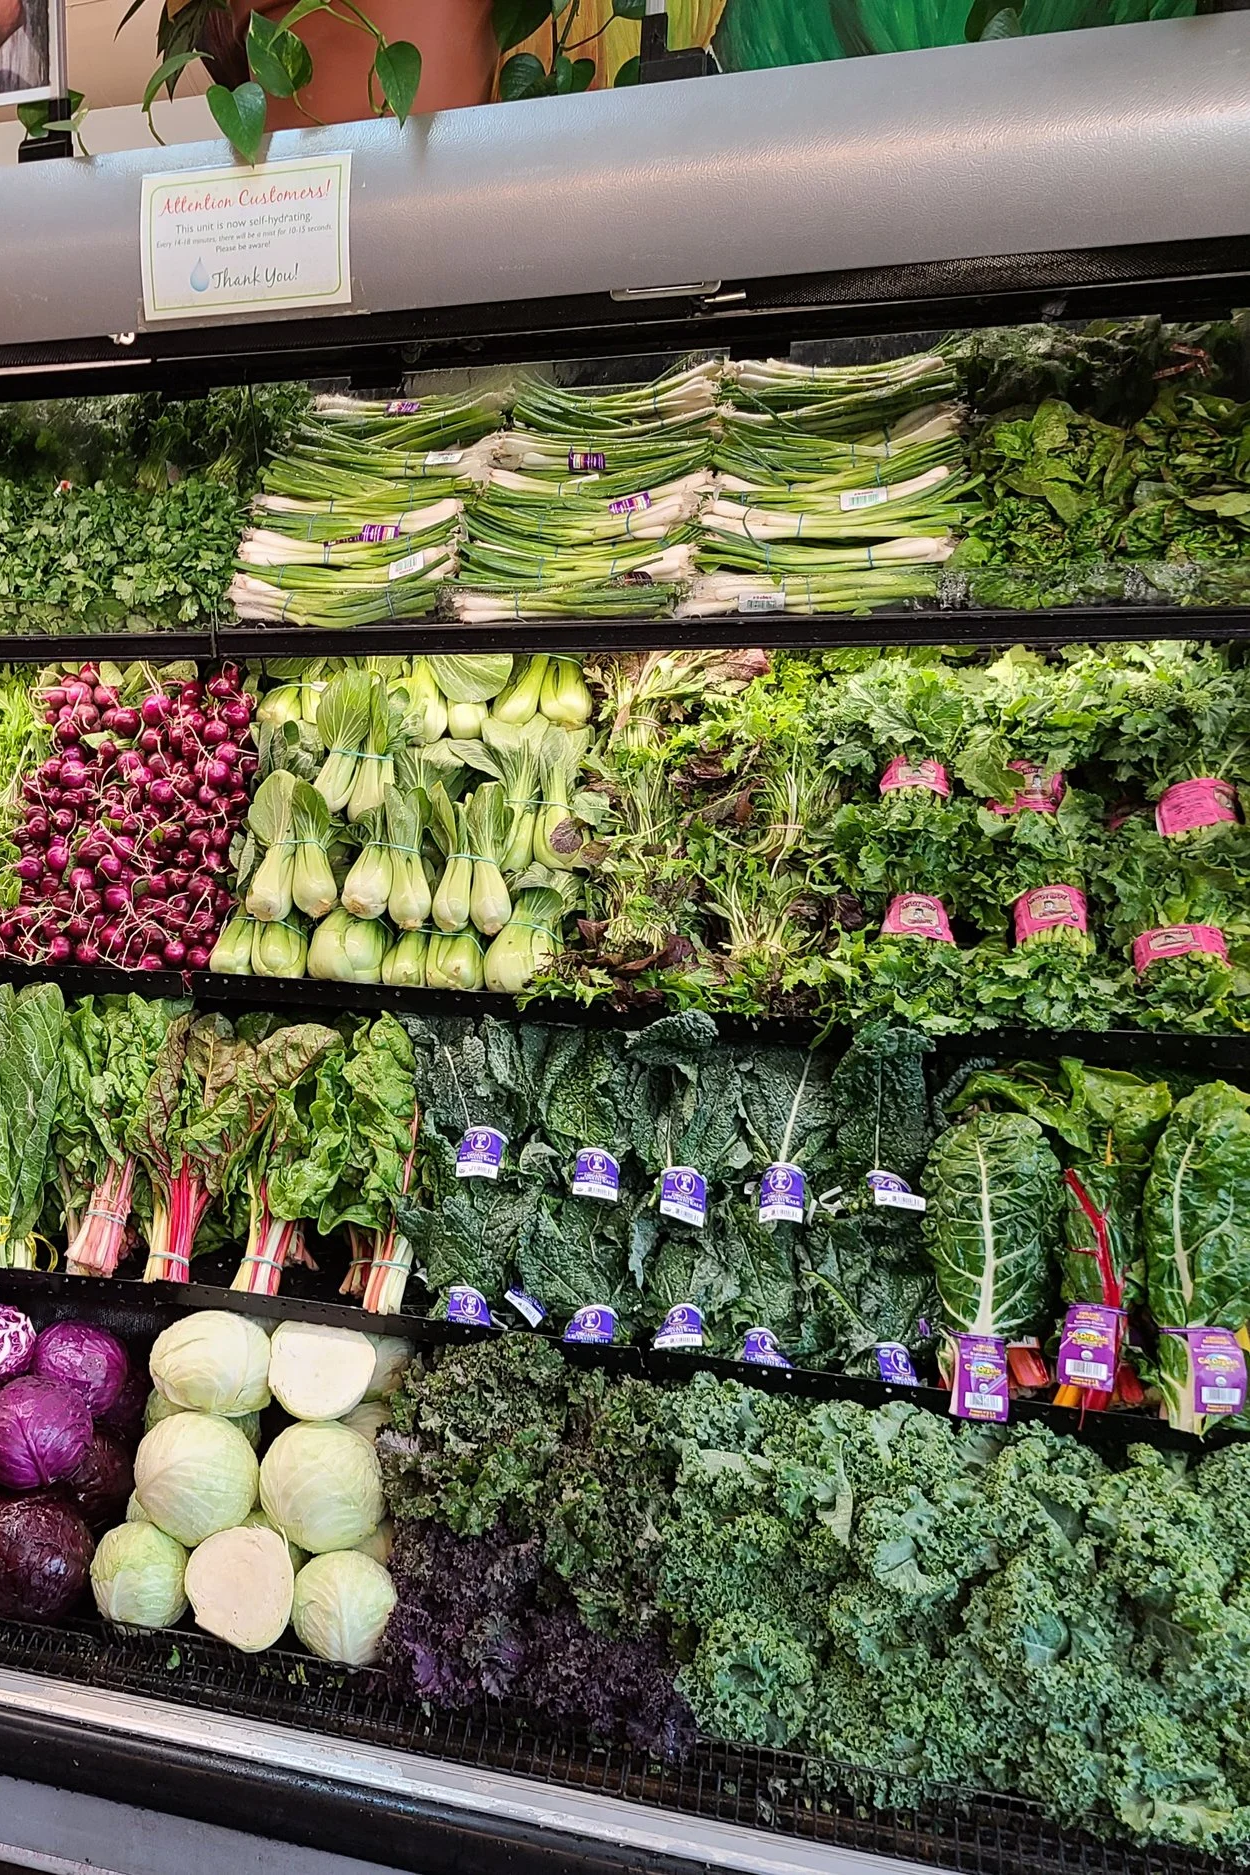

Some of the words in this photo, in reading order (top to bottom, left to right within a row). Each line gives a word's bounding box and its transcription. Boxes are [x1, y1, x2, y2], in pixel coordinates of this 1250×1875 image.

[159, 194, 233, 216] Attention
[238, 179, 331, 207] Customers!
[175, 224, 194, 234] This
[196, 223, 214, 232] unit
[216, 220, 224, 230] is
[226, 220, 247, 229] now
[215, 245, 236, 253] Please
[237, 243, 247, 251] be
[212, 265, 260, 289] Thank
[265, 262, 299, 288] You!
